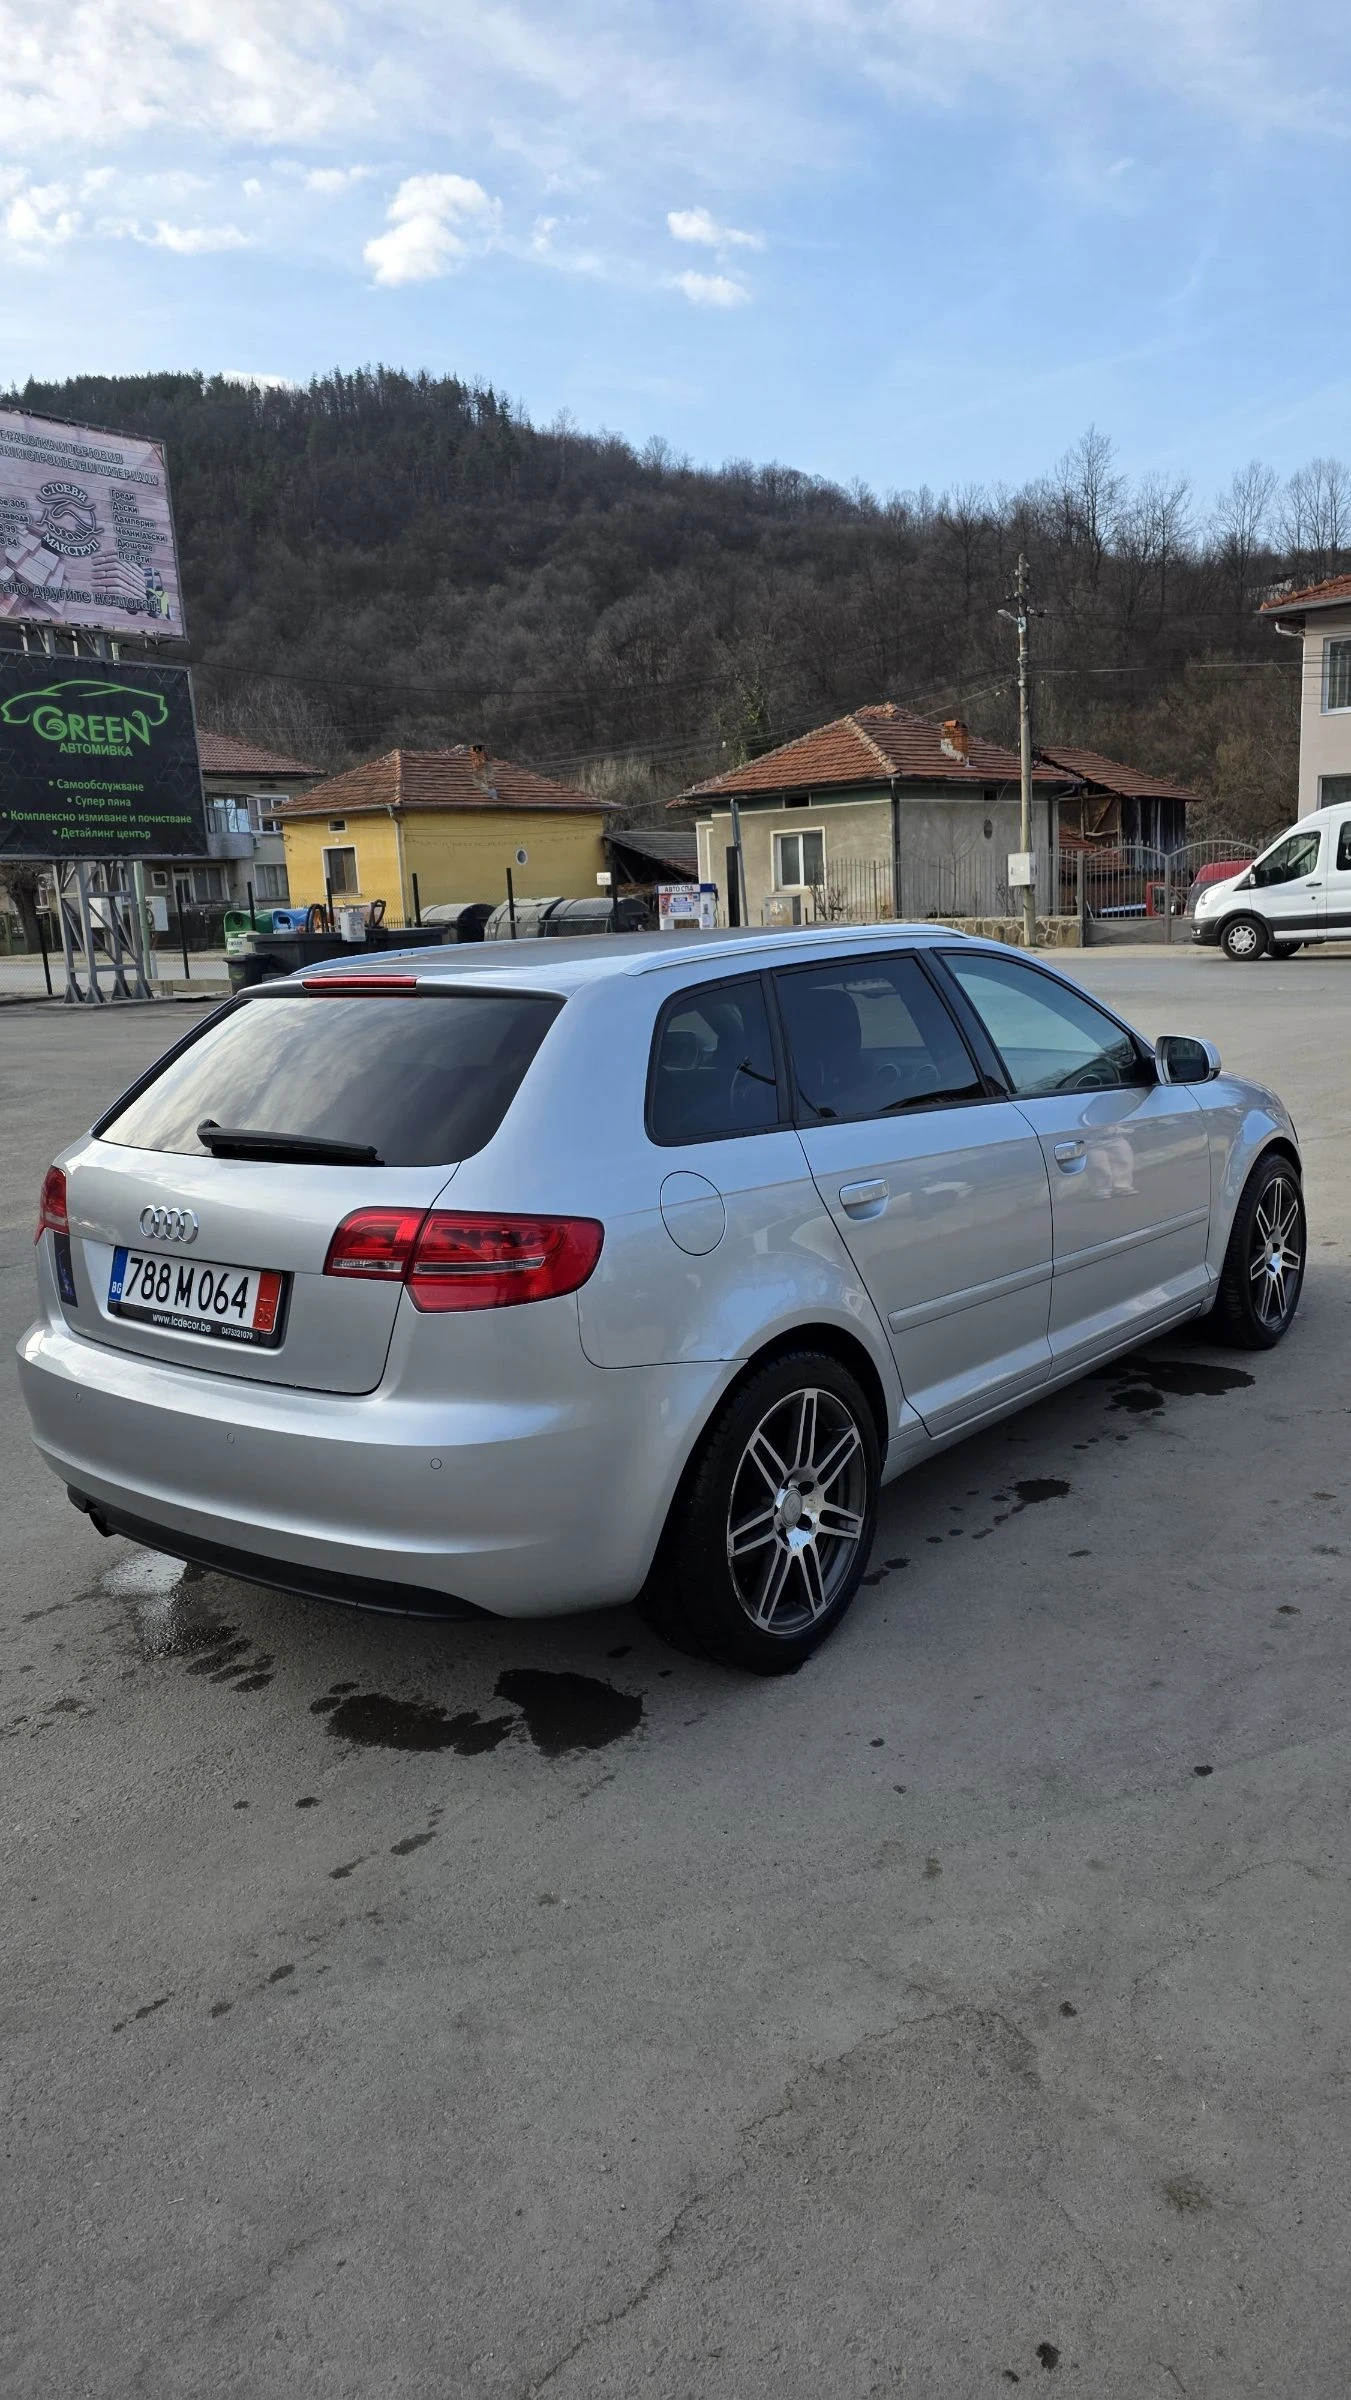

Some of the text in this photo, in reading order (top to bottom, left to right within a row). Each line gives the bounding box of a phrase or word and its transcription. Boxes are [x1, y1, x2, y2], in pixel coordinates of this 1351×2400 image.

[68, 443, 123, 464] ТЪРГОВИЯ
[26, 450, 96, 473] СТРОИТЕЛНИ
[97, 463, 158, 485] МАТЕРИАЛИ
[42, 482, 88, 503] СТОЕВИ
[111, 490, 135, 500] Греди
[10, 499, 26, 509] 305
[113, 502, 138, 513] Дъски
[114, 514, 155, 529] Ламперия
[42, 533, 99, 556] МАКСТРУП
[117, 539, 153, 552] Дюшеме
[119, 551, 151, 563] Пелети
[33, 584, 91, 603] другите
[33, 705, 150, 746] GREEN
[59, 742, 134, 757] АВТОМИВКА
[56, 778, 144, 793] Самообслужване
[75, 795, 132, 808] Супер пяна
[10, 810, 76, 821] Комплексно
[78, 813, 128, 823] измиване
[138, 814, 192, 823] почистване
[60, 827, 151, 840] Детайлинг център
[111, 1281, 122, 1294] BG
[125, 1257, 171, 1303] 788
[198, 1269, 249, 1319] 064
